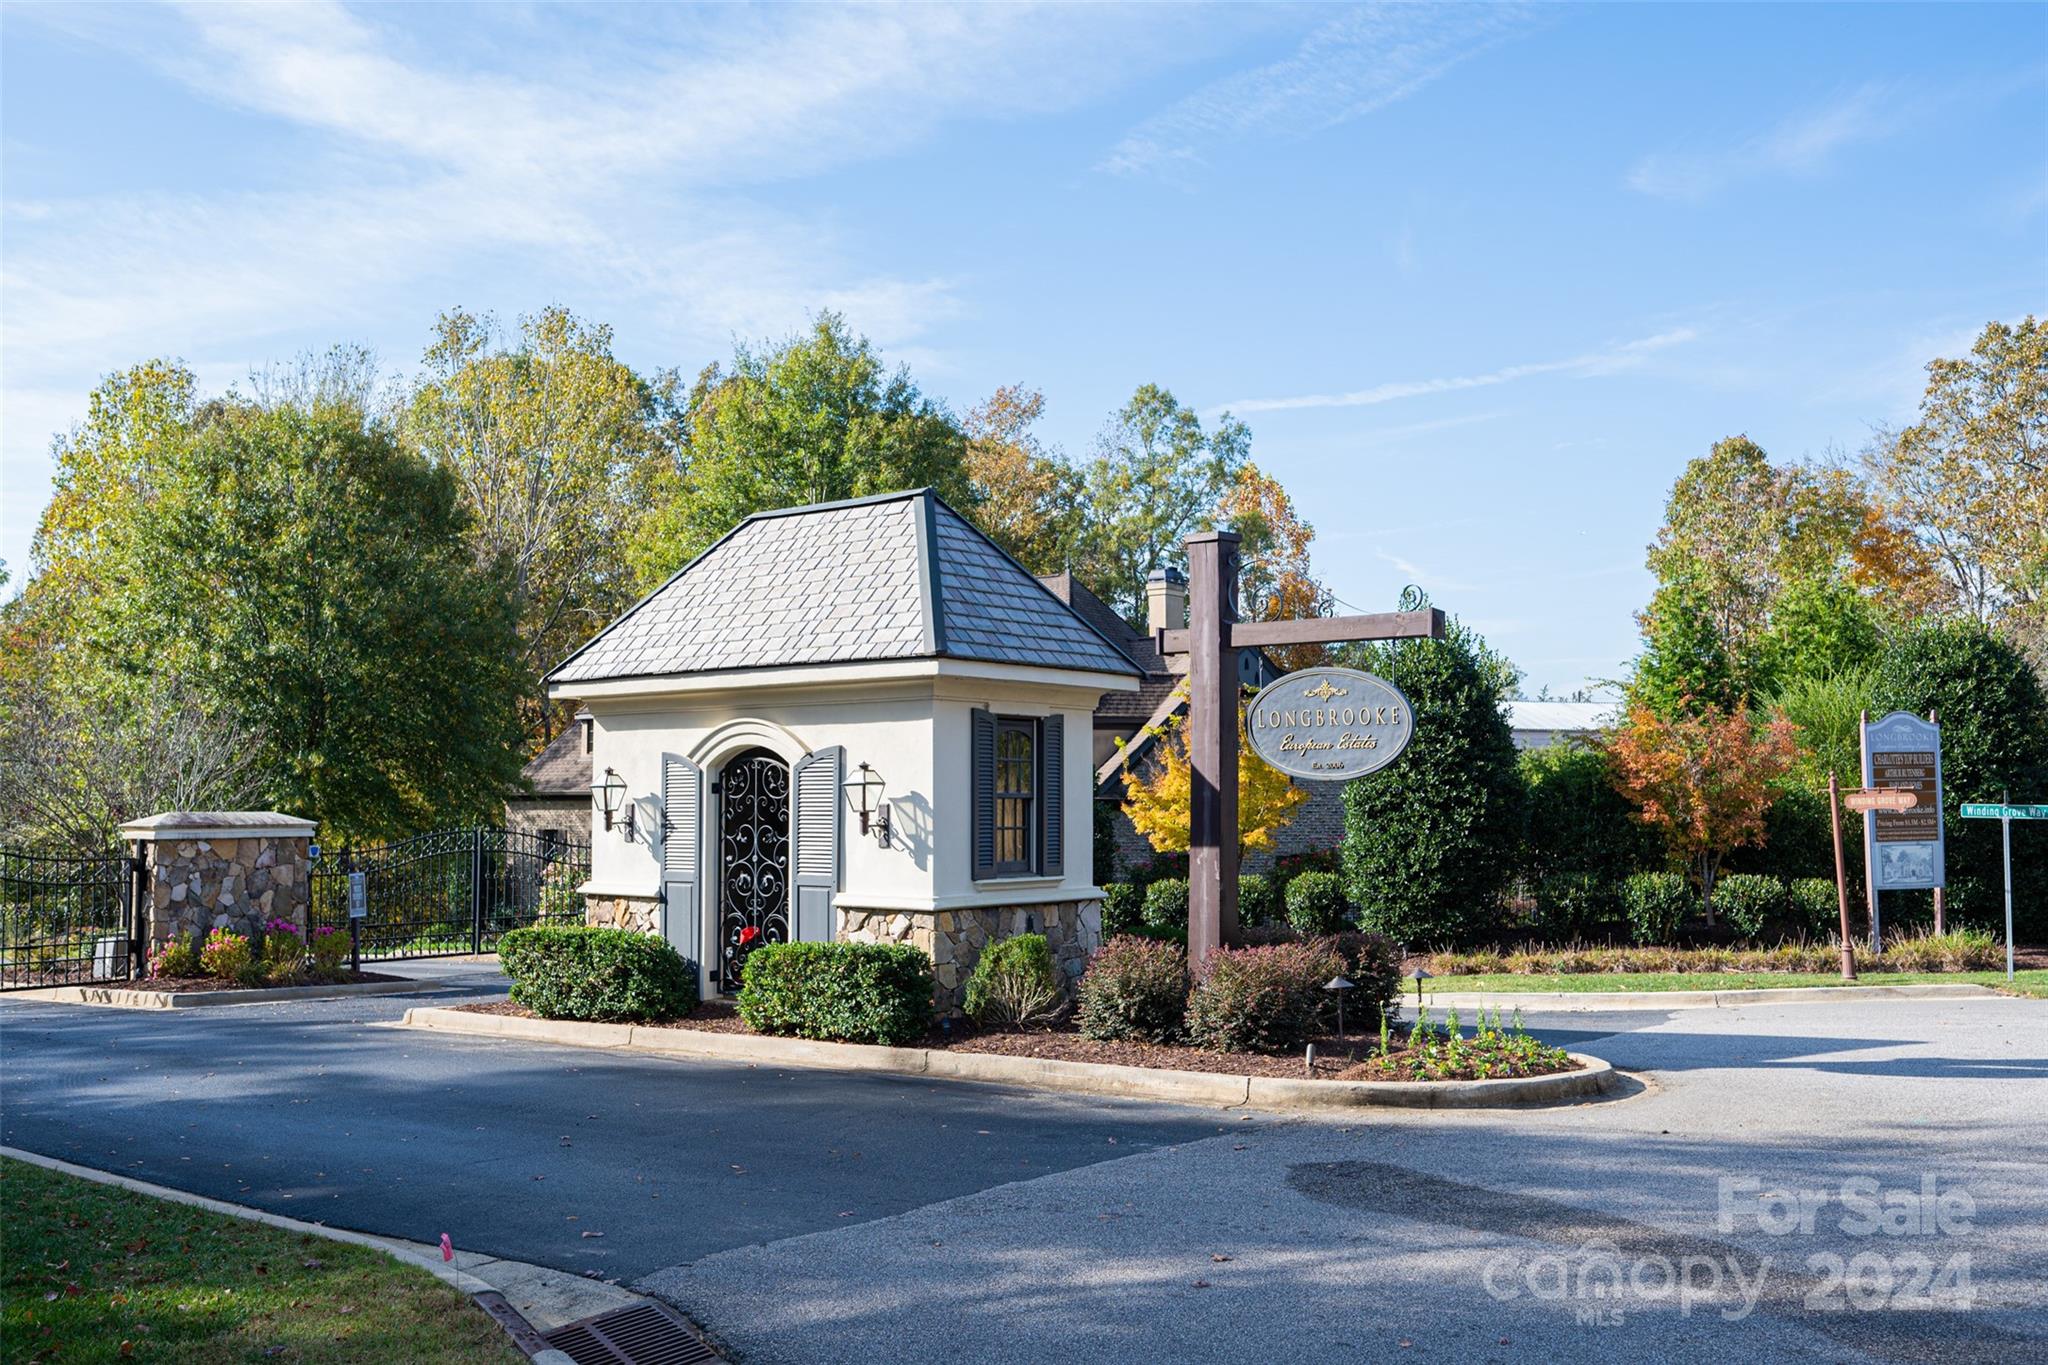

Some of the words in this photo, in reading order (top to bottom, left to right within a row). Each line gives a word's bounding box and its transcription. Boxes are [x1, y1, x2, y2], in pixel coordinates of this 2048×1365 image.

[1258, 706, 1400, 729] LONGBROOKE
[1279, 732, 1334, 757] European
[1336, 732, 1378, 750] Estates
[1966, 806, 2000, 817] Winding
[2002, 806, 2026, 817] Grove
[2028, 807, 2046, 818] Way
